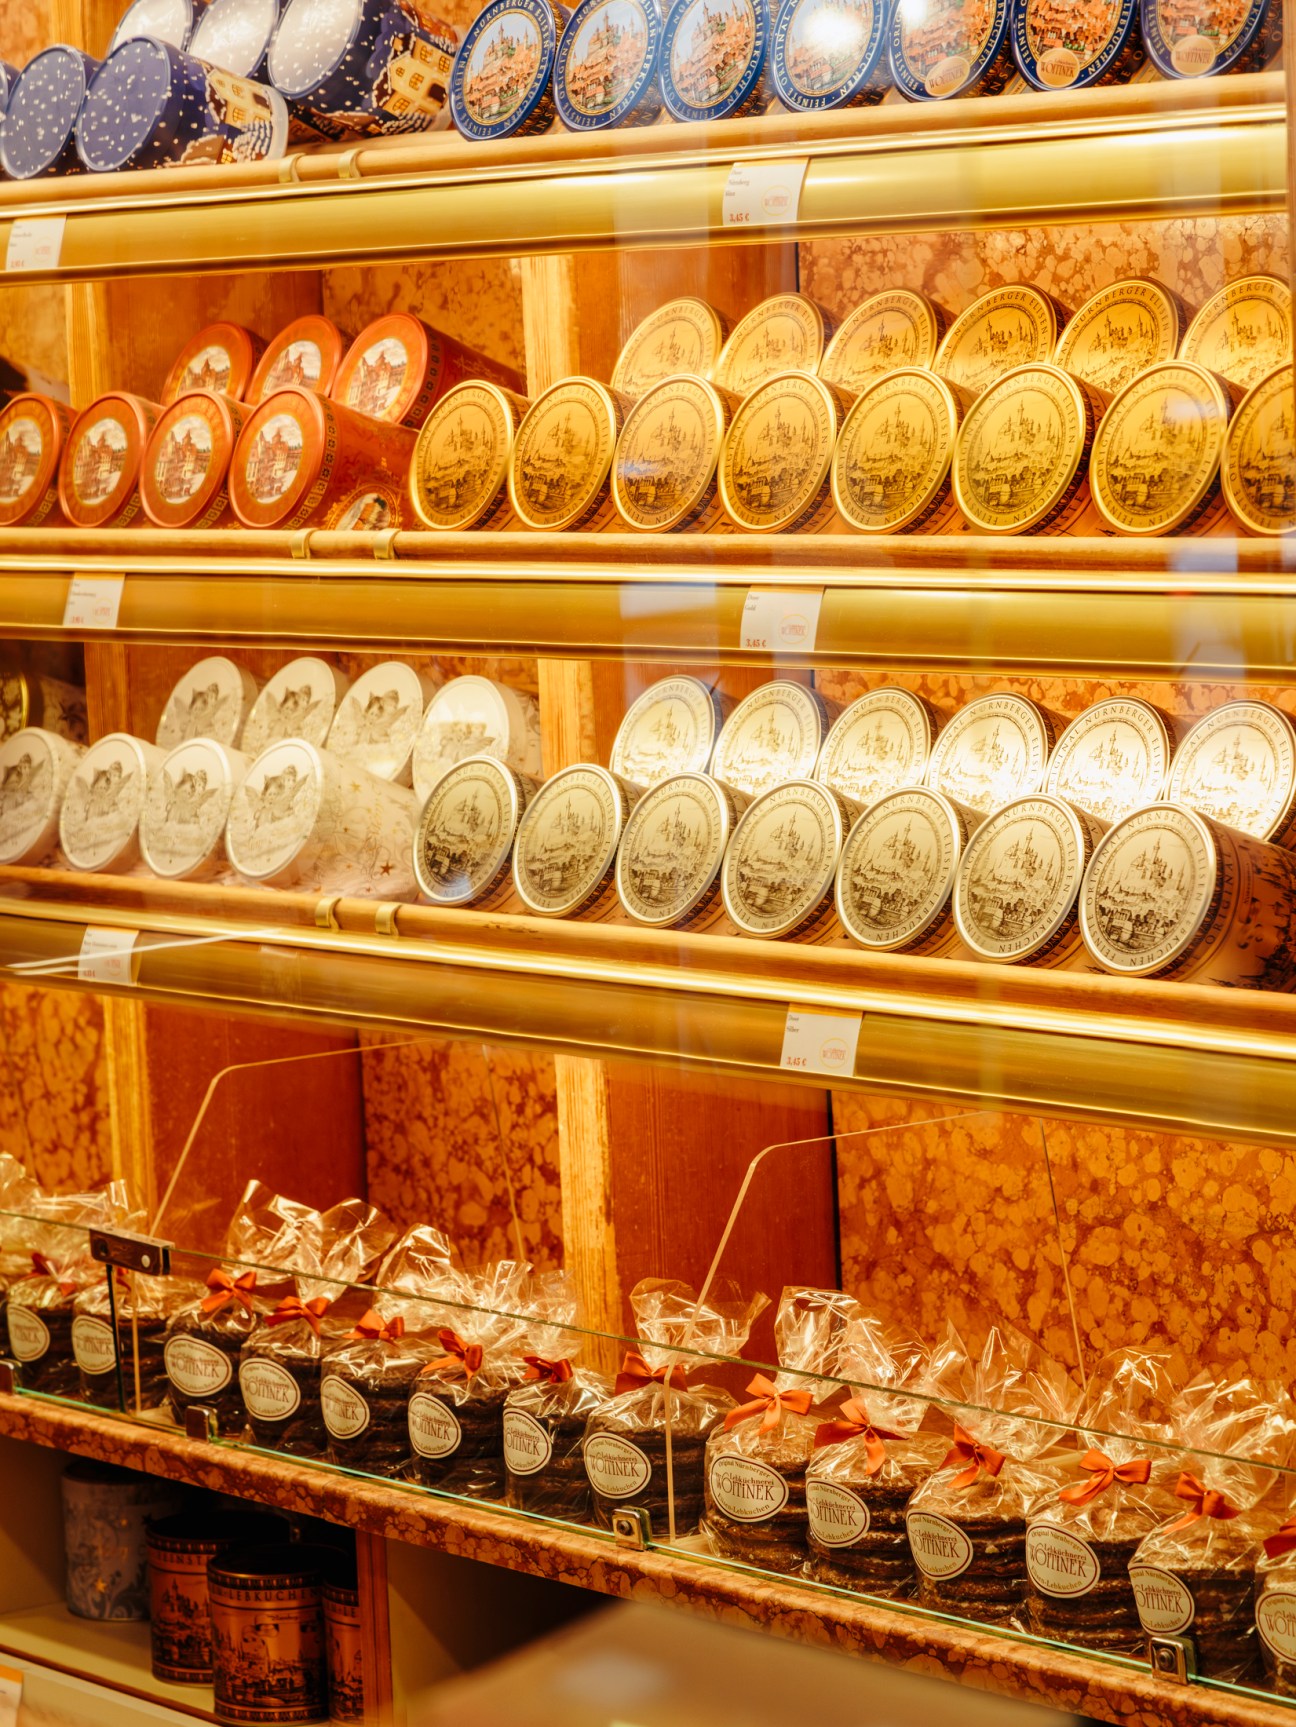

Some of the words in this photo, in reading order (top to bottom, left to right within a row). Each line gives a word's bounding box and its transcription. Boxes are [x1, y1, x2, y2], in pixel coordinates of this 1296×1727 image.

[1017, 13, 1034, 65] FEINSTE
[787, 88, 826, 108] FEINSTE
[745, 638, 761, 648] 3,45
[786, 1056, 801, 1067] 3,45
[1135, 1588, 1184, 1614] OITINEK
